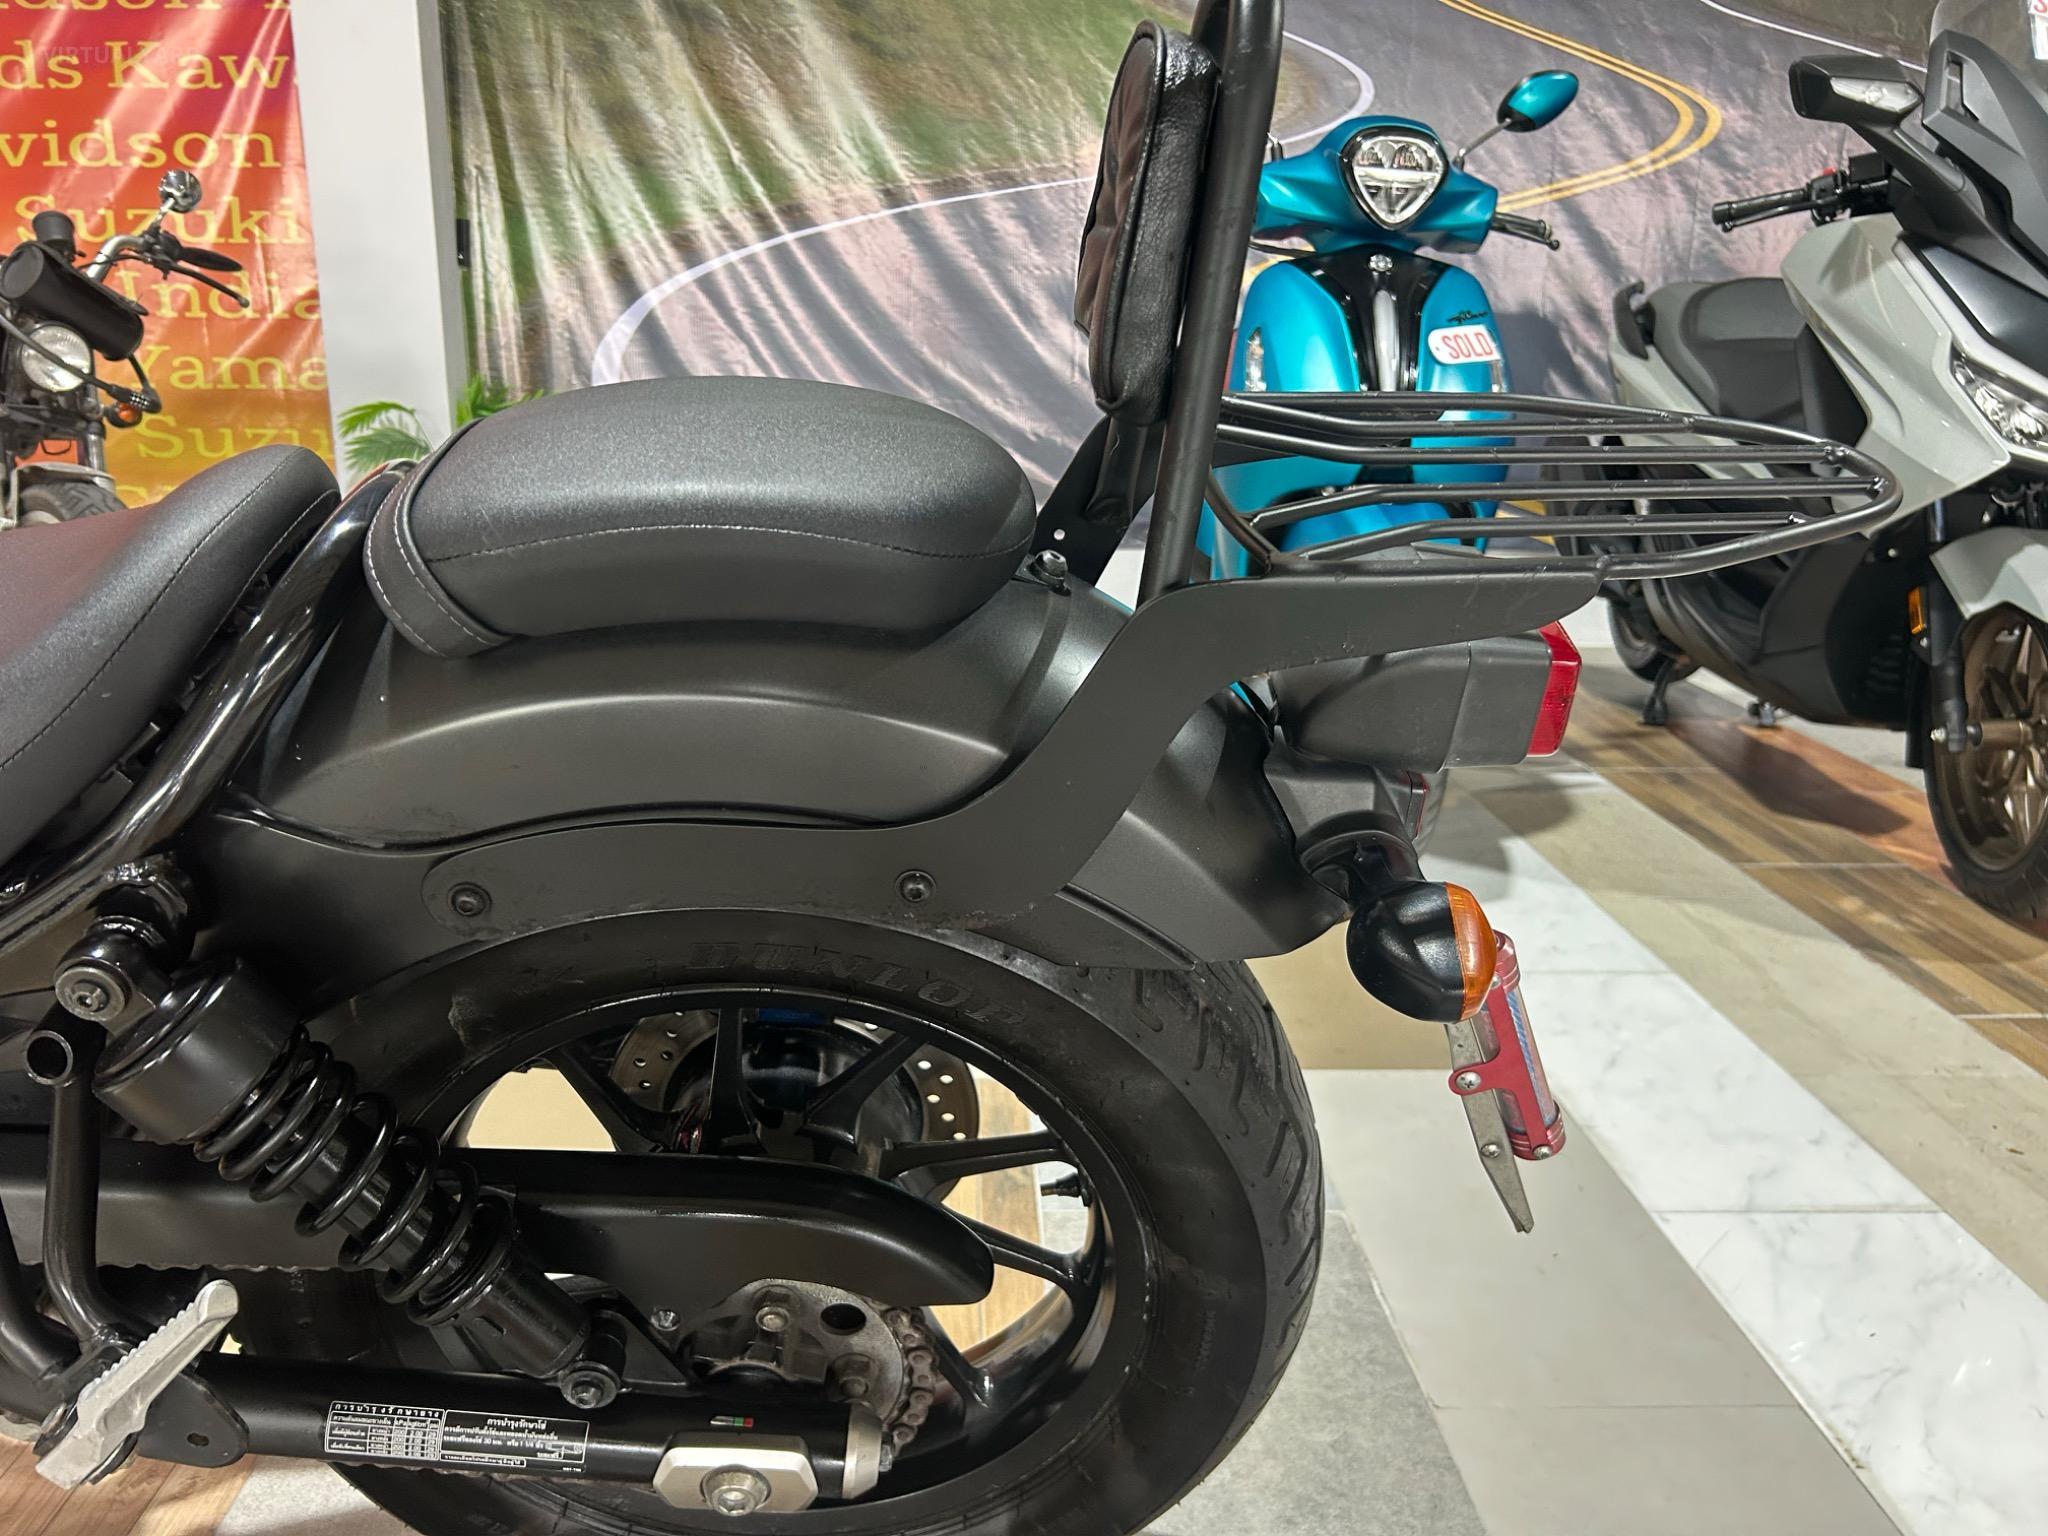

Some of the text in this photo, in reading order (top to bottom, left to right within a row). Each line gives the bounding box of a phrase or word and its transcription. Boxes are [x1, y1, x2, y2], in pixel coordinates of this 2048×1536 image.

[0, 39, 289, 90] ds Kaw
[0, 119, 281, 169] vidson
[1442, 332, 1494, 360] SOLD
